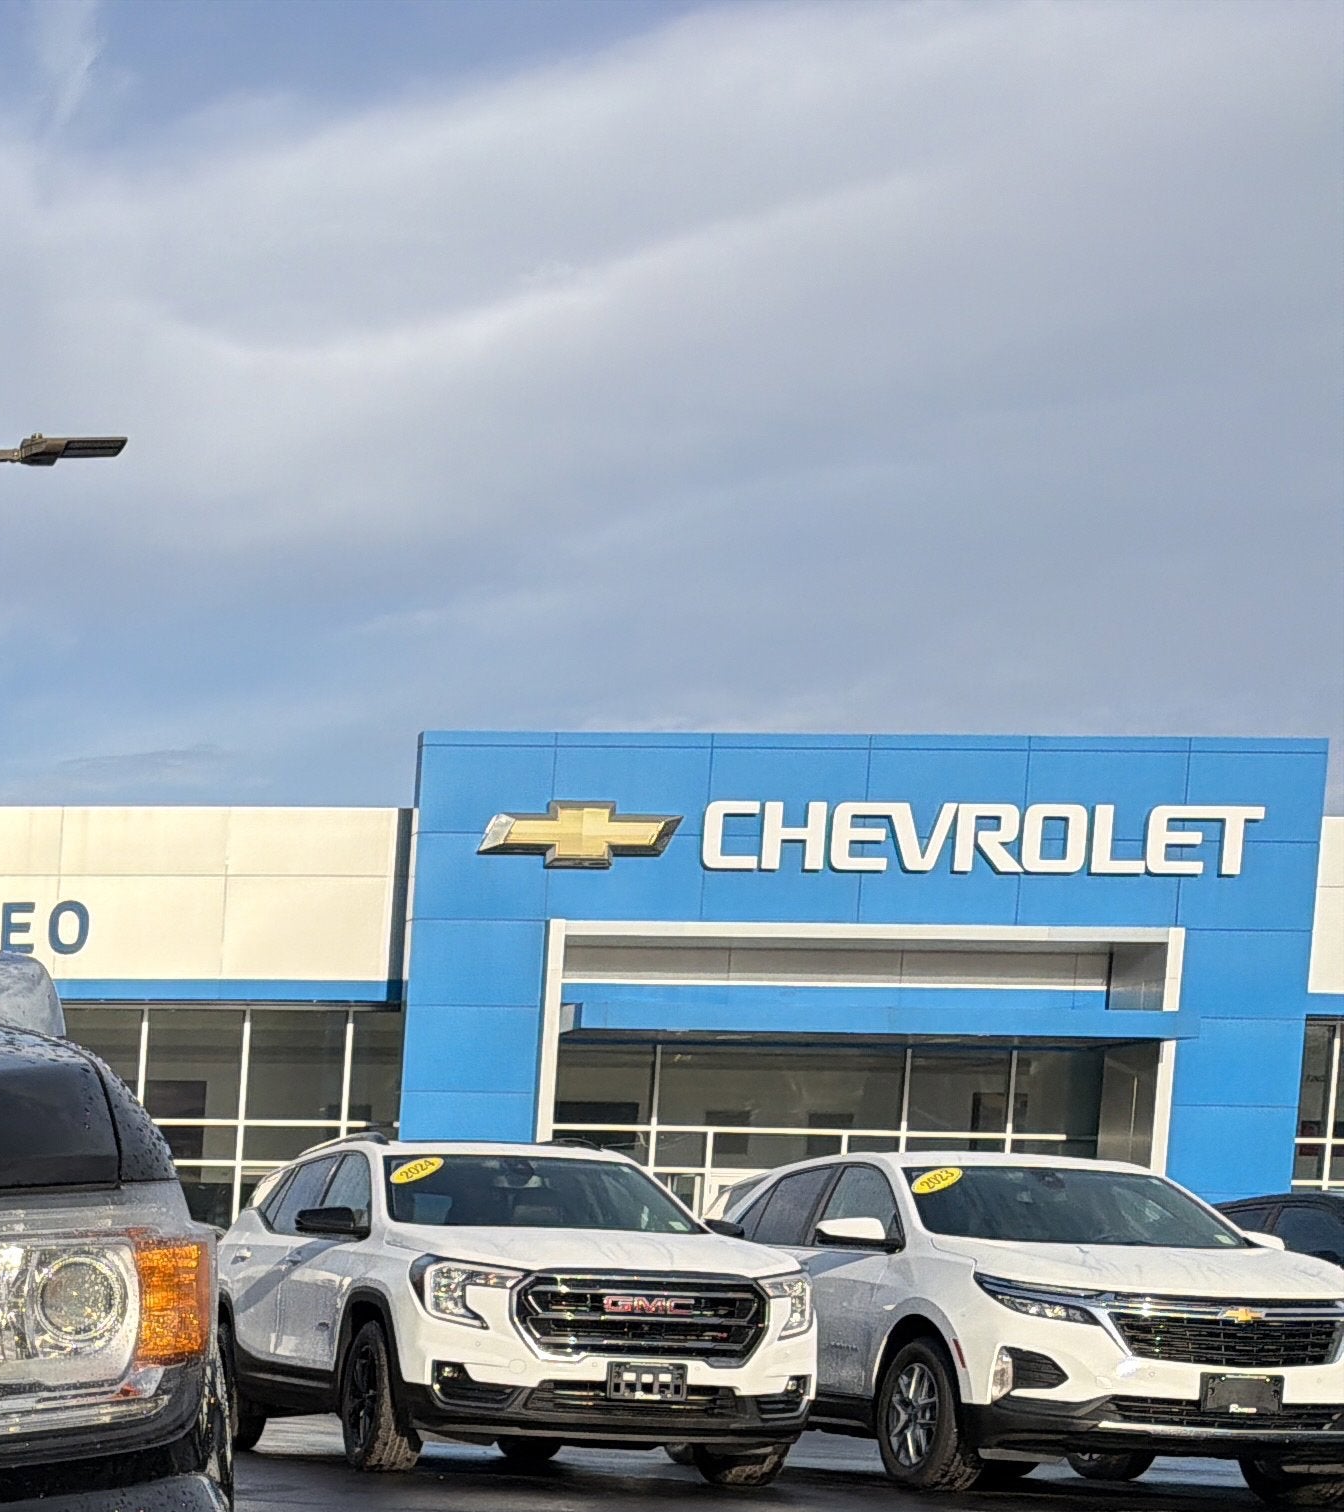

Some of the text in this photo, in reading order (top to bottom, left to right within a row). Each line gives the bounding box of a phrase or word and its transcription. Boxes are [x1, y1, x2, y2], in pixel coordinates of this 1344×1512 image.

[703, 800, 1265, 876] CHEVROLET
[400, 1160, 435, 1179] 2024
[920, 1170, 954, 1189] 2023
[603, 1296, 695, 1315] GMC
